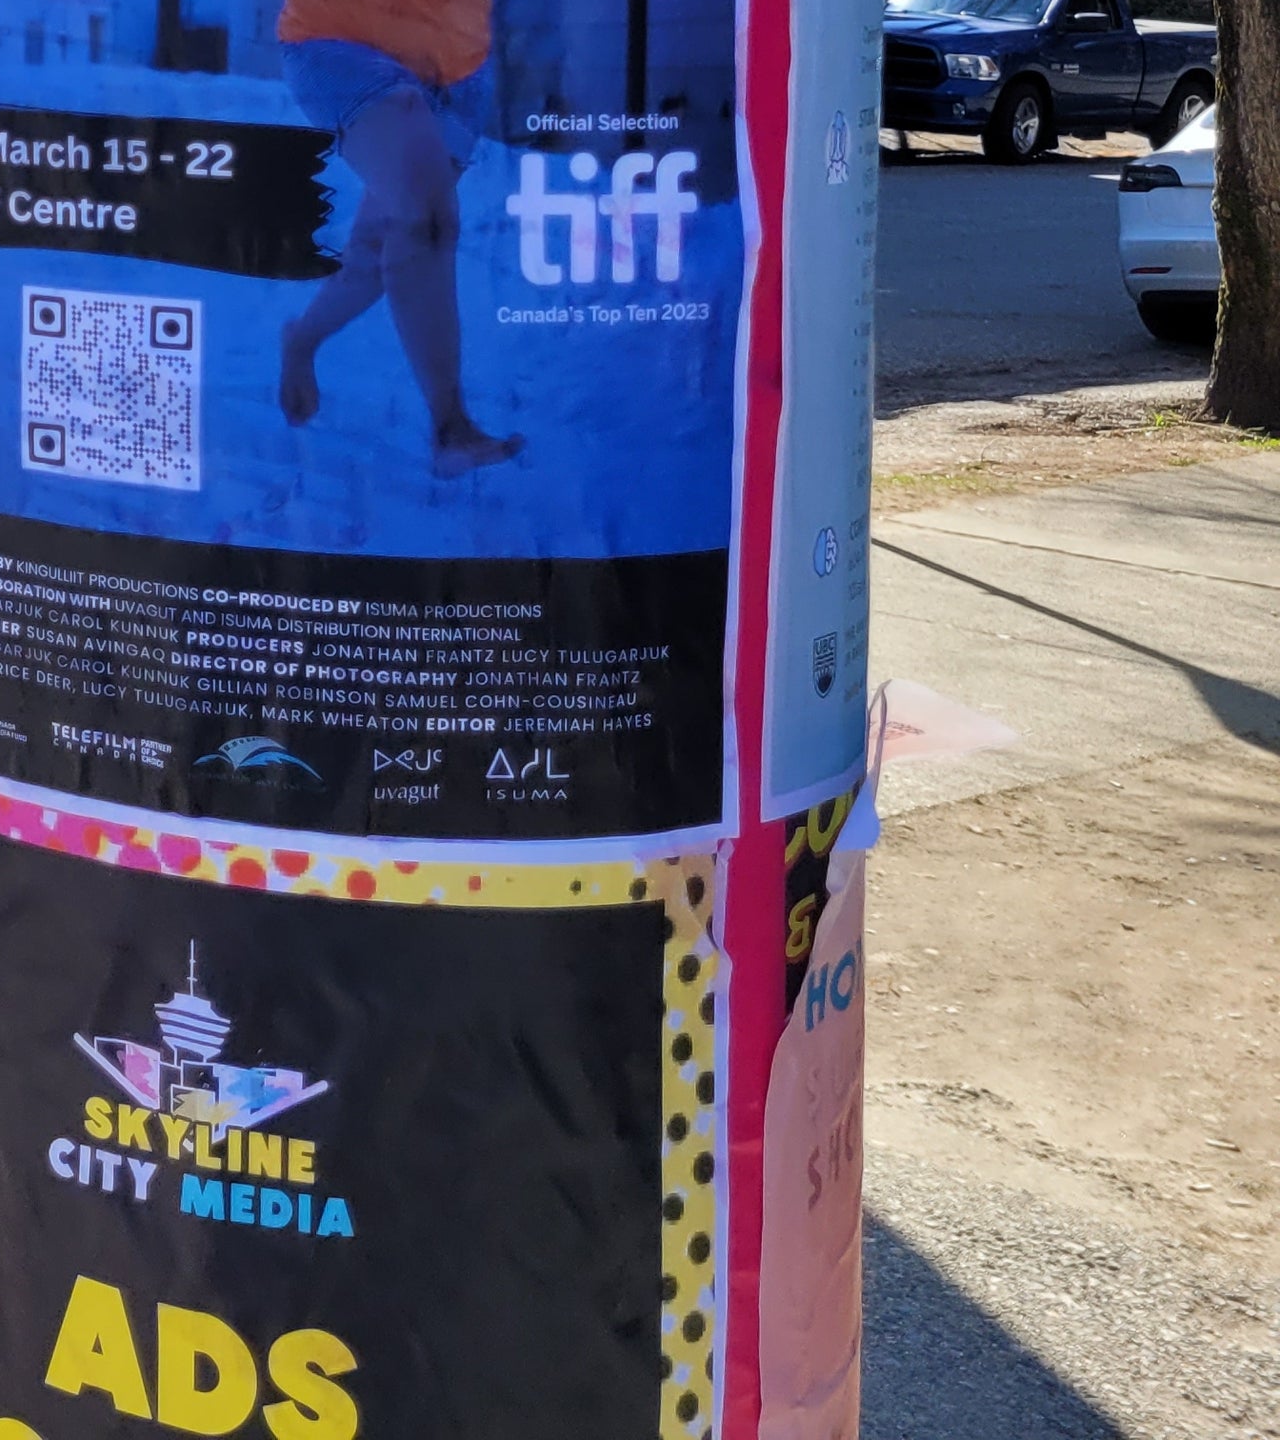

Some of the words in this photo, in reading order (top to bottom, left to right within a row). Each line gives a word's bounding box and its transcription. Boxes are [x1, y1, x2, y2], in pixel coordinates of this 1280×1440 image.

[526, 113, 592, 132] Official
[598, 113, 679, 132] Selection
[102, 139, 148, 173] 15
[185, 142, 234, 178] 22
[8, 188, 137, 231] Centre
[506, 151, 698, 286] tiff
[497, 305, 584, 324] Canada's
[588, 305, 622, 326] Top
[626, 304, 657, 322] Ten
[661, 303, 710, 321] 2023
[16, 561, 85, 584] KINGULLIIT
[89, 573, 199, 601] PRODUCTIONS
[202, 589, 334, 613] CO-PRODUCED
[337, 600, 361, 615] BY
[366, 601, 418, 618] ISUMA
[424, 604, 542, 619] PRODUCTIONS
[70, 592, 111, 610] WITH
[115, 599, 177, 622] UVAGUT
[181, 610, 216, 625] AND
[221, 613, 272, 631] ISUMA
[278, 618, 390, 640] DISTRIBUTION
[396, 626, 523, 642] INTERNATIONAL
[26, 625, 77, 649] SUSAN
[84, 638, 166, 664] AVINGAQ
[171, 651, 268, 675] DIRECTOR
[274, 662, 299, 678] OF
[305, 664, 458, 687] PHOTOGRAPHY
[465, 671, 568, 688] JONATHAN
[576, 670, 641, 687] FRANTZ
[48, 609, 104, 631] CAROL
[110, 619, 180, 644] KUNNUK
[187, 631, 305, 655] PRODUCERS
[312, 643, 418, 663] JONATHAN
[425, 648, 495, 665] FRANTZ
[502, 649, 550, 664] LUCY
[558, 645, 671, 664] TULUGARJUK
[36, 669, 77, 695] DEER,
[83, 680, 127, 700] LUCY
[134, 688, 255, 720] TULUGARJUK,
[262, 705, 314, 725] MARK
[322, 711, 418, 732] WHEATON
[426, 717, 496, 733] EDITOR
[504, 718, 595, 733] JEREMIAH
[603, 713, 653, 733] HAYES
[57, 654, 115, 676] CAROL
[121, 664, 191, 690] KUNNUK
[197, 677, 268, 697] GILLIAN
[276, 684, 376, 707] ROBINSON
[385, 693, 458, 710] SAMUEL
[465, 693, 637, 710] COHN-COUSINEAU
[52, 722, 137, 750] TELEFILM
[374, 784, 441, 805] uvagut
[486, 789, 569, 801] ISUMA
[84, 1096, 316, 1184] SKYLINE
[48, 1138, 158, 1201] CITY
[180, 1173, 354, 1238] MEDIA
[44, 1274, 360, 1440] ADS
